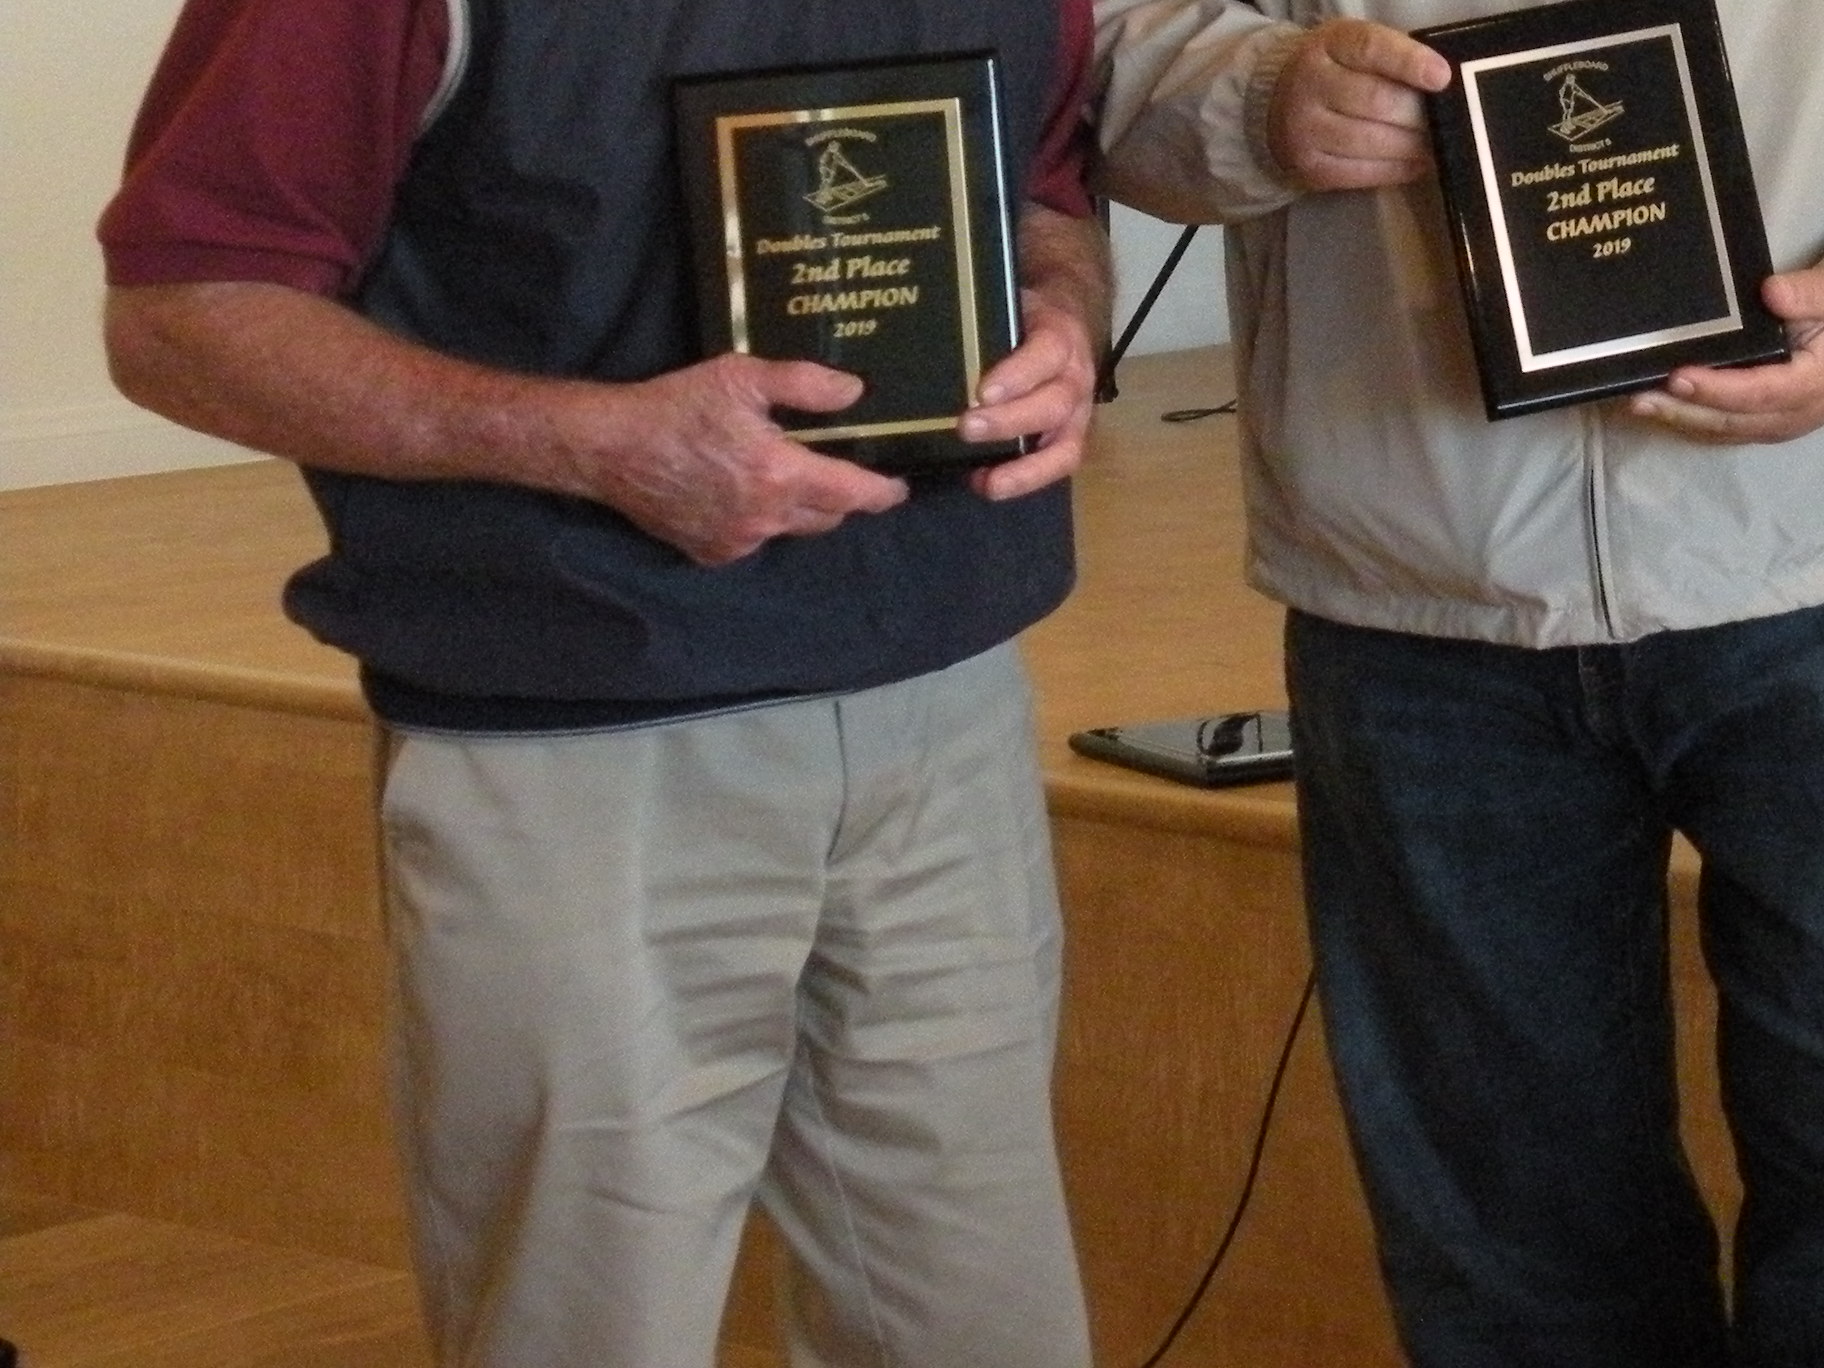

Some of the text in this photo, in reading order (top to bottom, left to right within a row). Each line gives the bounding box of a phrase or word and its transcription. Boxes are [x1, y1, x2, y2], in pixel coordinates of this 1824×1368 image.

[1511, 143, 1680, 187] Doubles Tournament
[1546, 176, 1656, 212] 2nd Place
[1546, 201, 1667, 242] CHAMPION
[756, 225, 942, 255] Doubles Tournament
[1592, 237, 1632, 259] 2019
[791, 254, 911, 285] 2nd Place
[786, 285, 920, 316] CHAMPION
[832, 318, 878, 338] 2019
